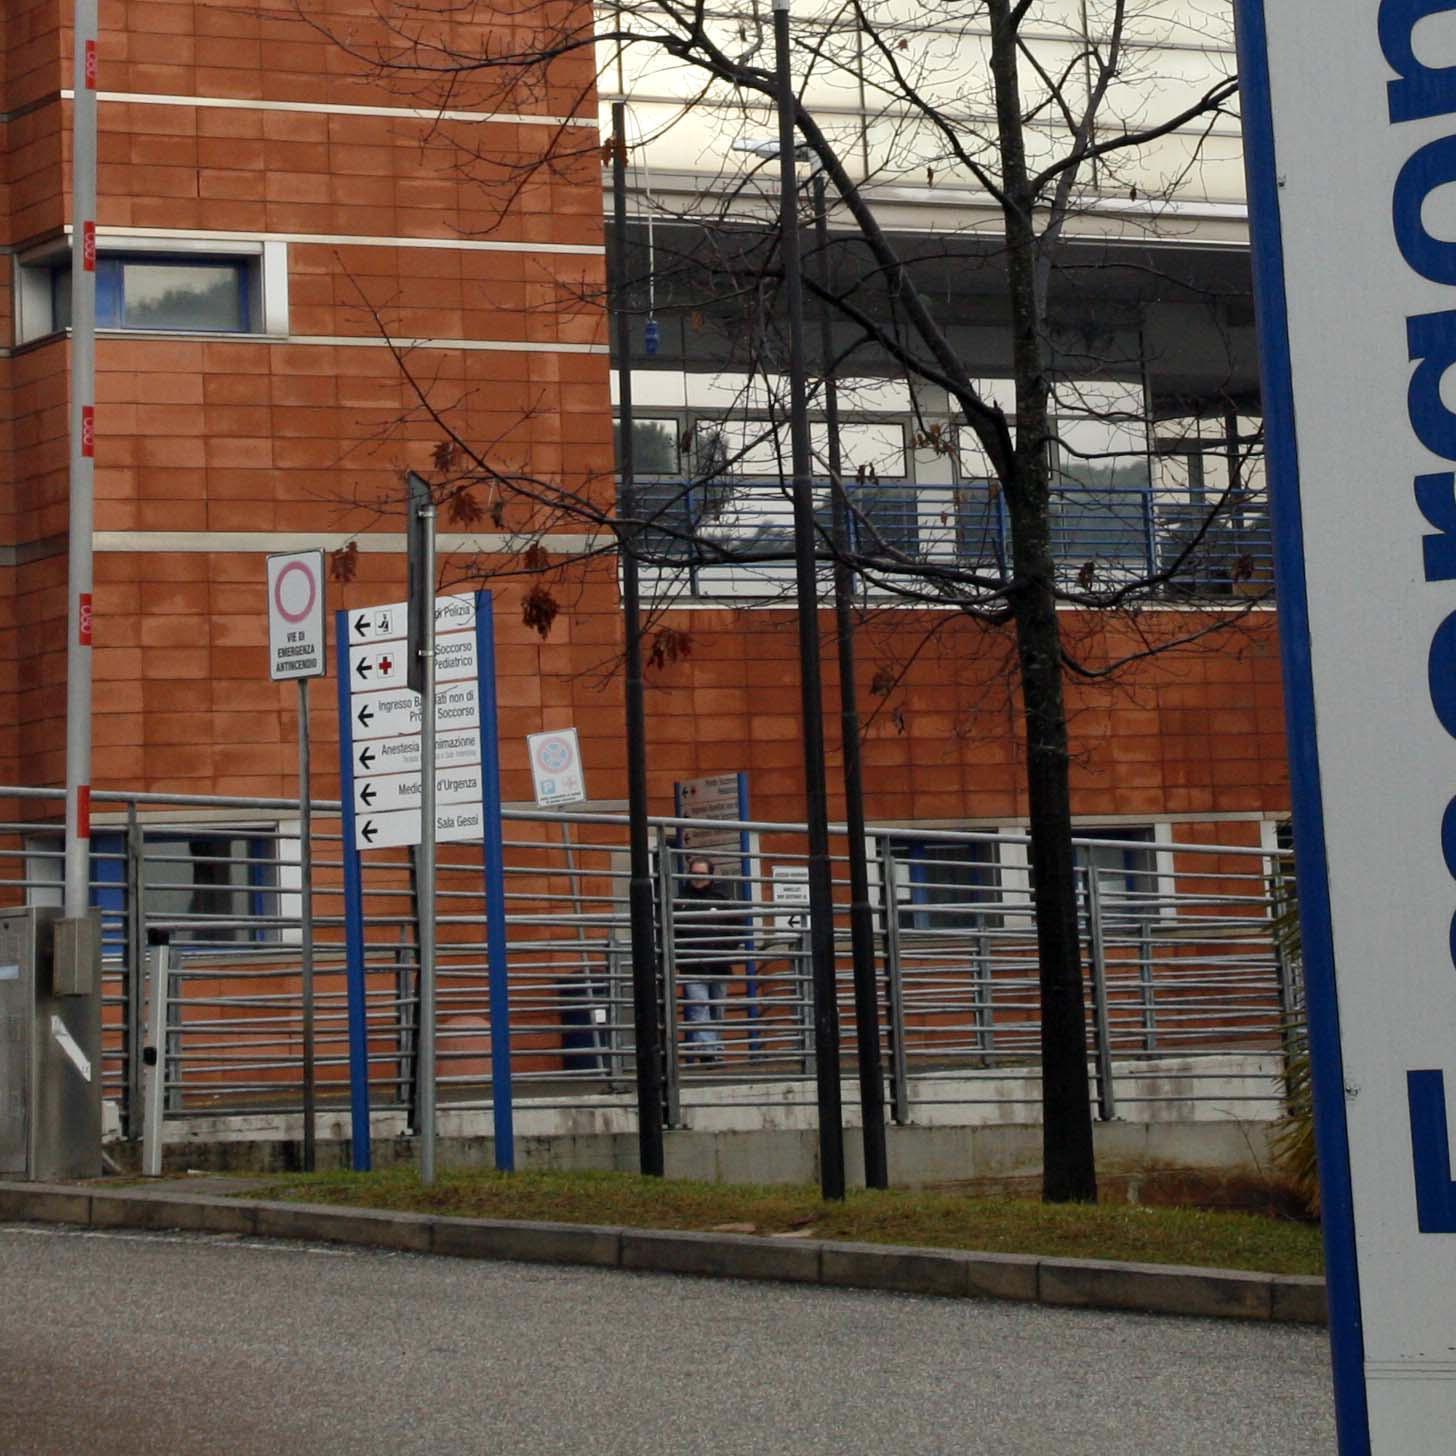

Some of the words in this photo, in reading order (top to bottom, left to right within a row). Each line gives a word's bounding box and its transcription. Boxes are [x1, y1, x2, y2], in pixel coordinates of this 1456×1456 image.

[277, 644, 316, 658] EMERGENZA
[434, 642, 473, 655] Soccorso
[276, 658, 318, 672] ANTINCENDIO
[378, 697, 412, 713] Ingresso
[449, 694, 465, 704] non
[466, 690, 475, 701] di
[437, 706, 475, 720] Soccorso
[381, 742, 420, 756] Anestesia
[436, 777, 478, 793] d'Urgenza
[436, 816, 455, 830] Sala
[456, 814, 479, 828] Gessi
